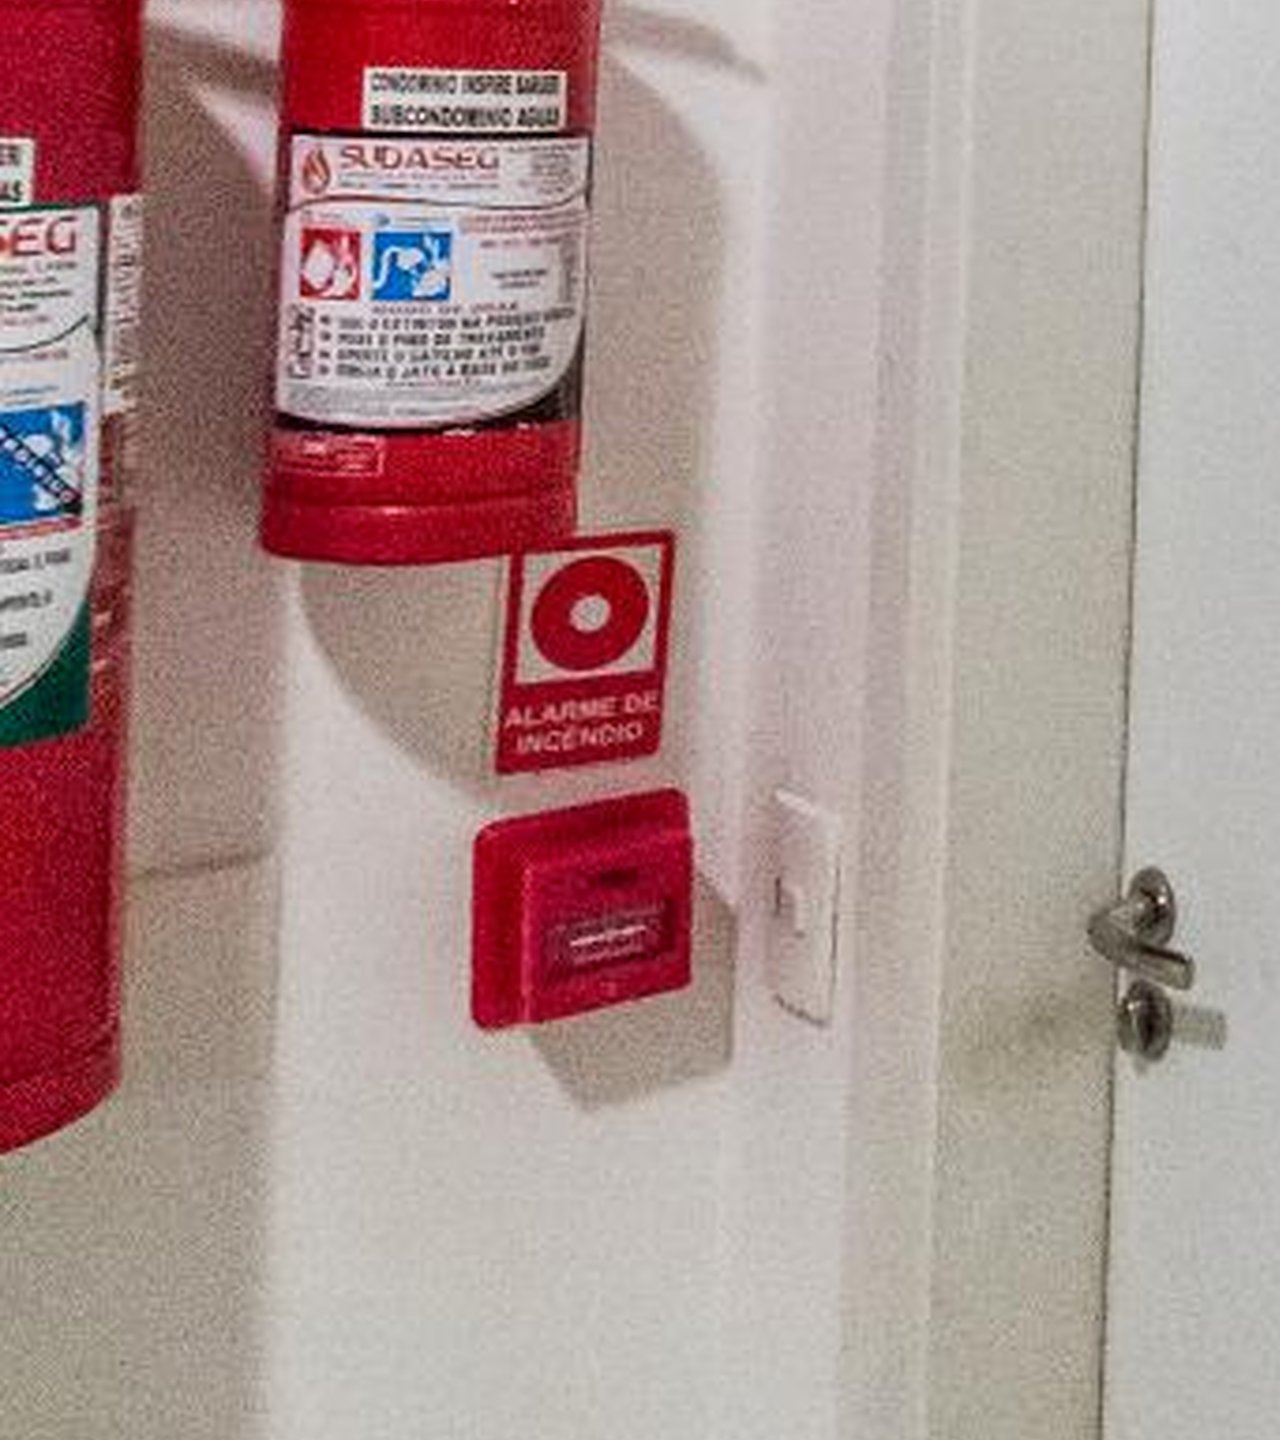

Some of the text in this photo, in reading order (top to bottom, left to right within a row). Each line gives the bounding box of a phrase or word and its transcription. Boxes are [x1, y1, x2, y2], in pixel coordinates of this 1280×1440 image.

[340, 144, 499, 170] SUDASEG
[504, 689, 661, 728] ALARME DE
